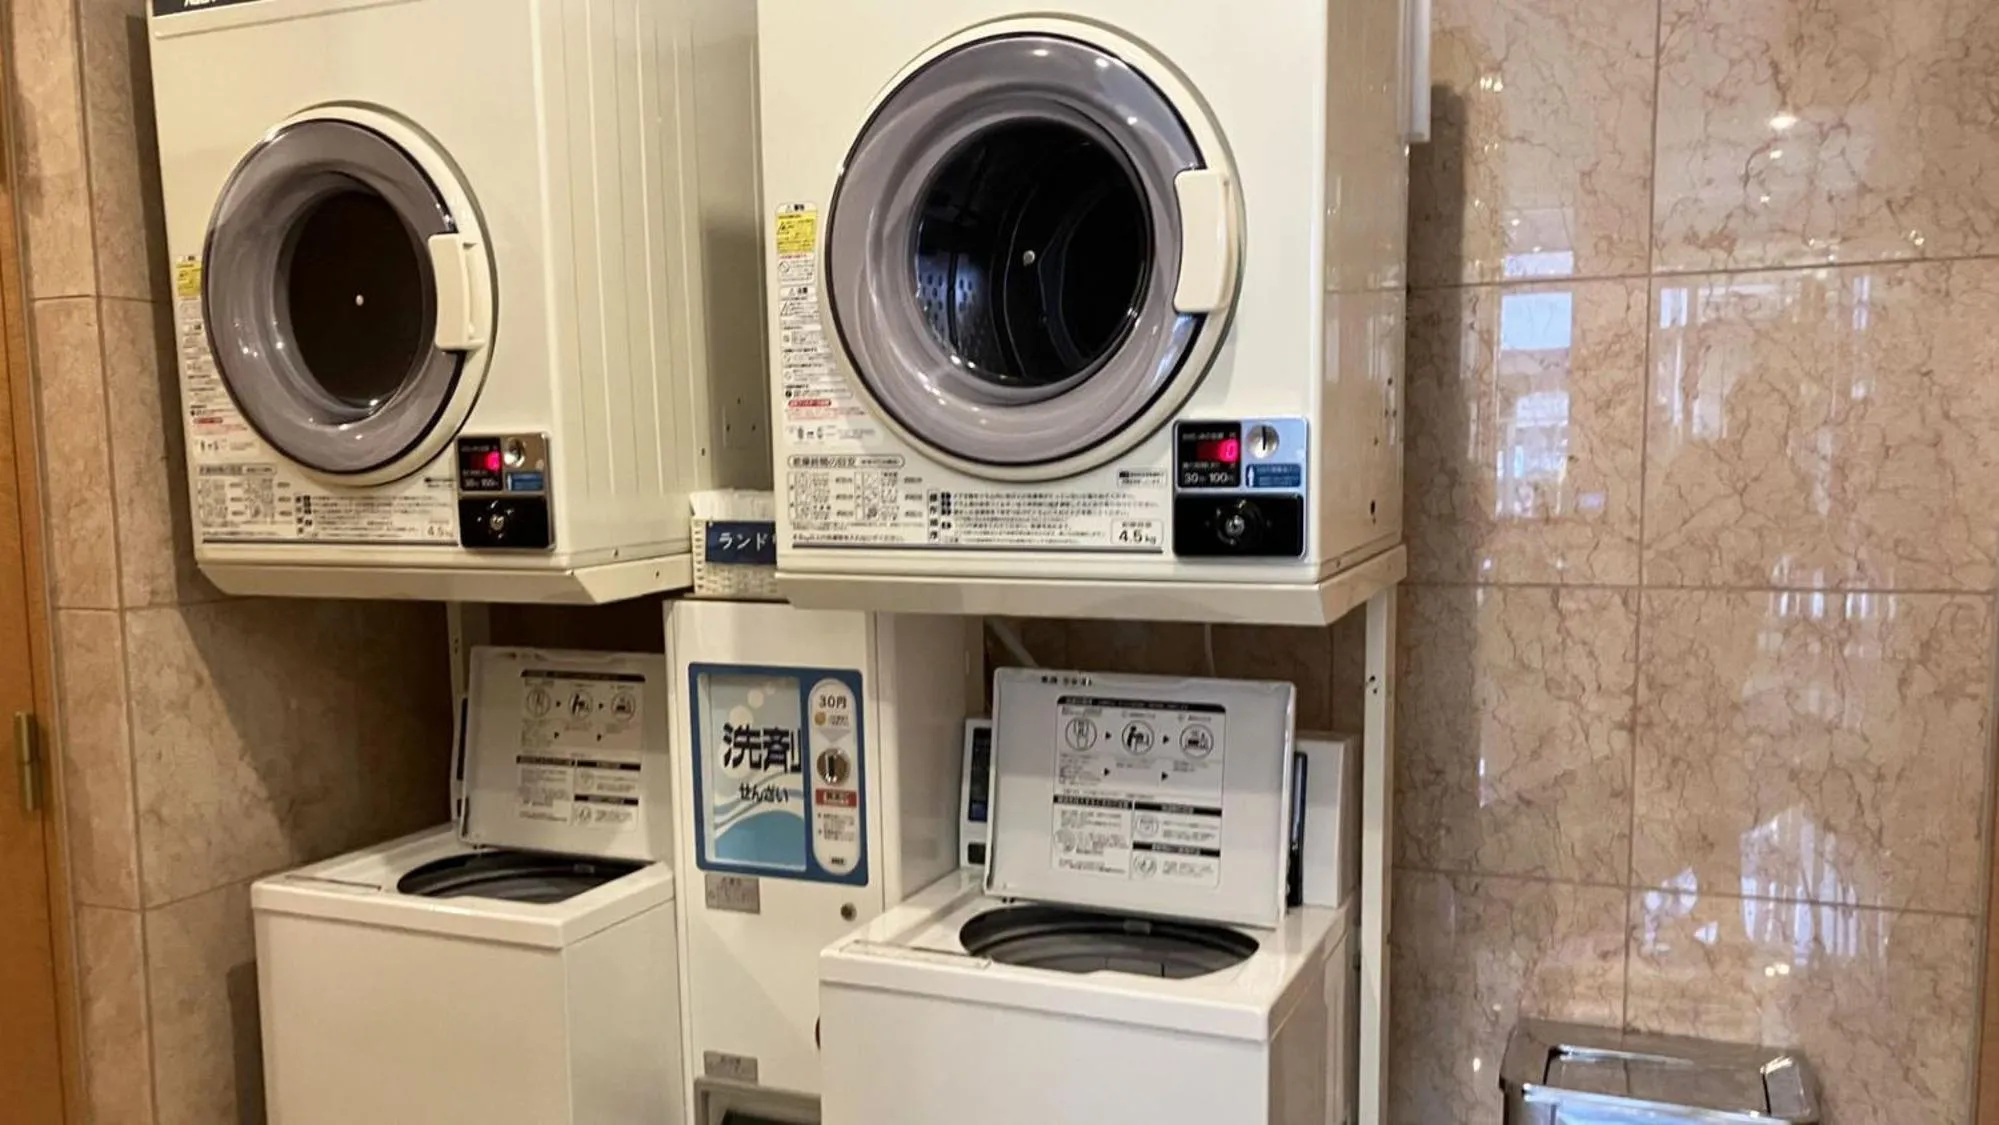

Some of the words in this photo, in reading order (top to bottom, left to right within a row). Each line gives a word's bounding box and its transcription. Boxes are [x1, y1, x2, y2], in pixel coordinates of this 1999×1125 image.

[718, 531, 776, 552] ランド
[818, 695, 848, 710] 30円
[738, 782, 790, 804] せんざい
